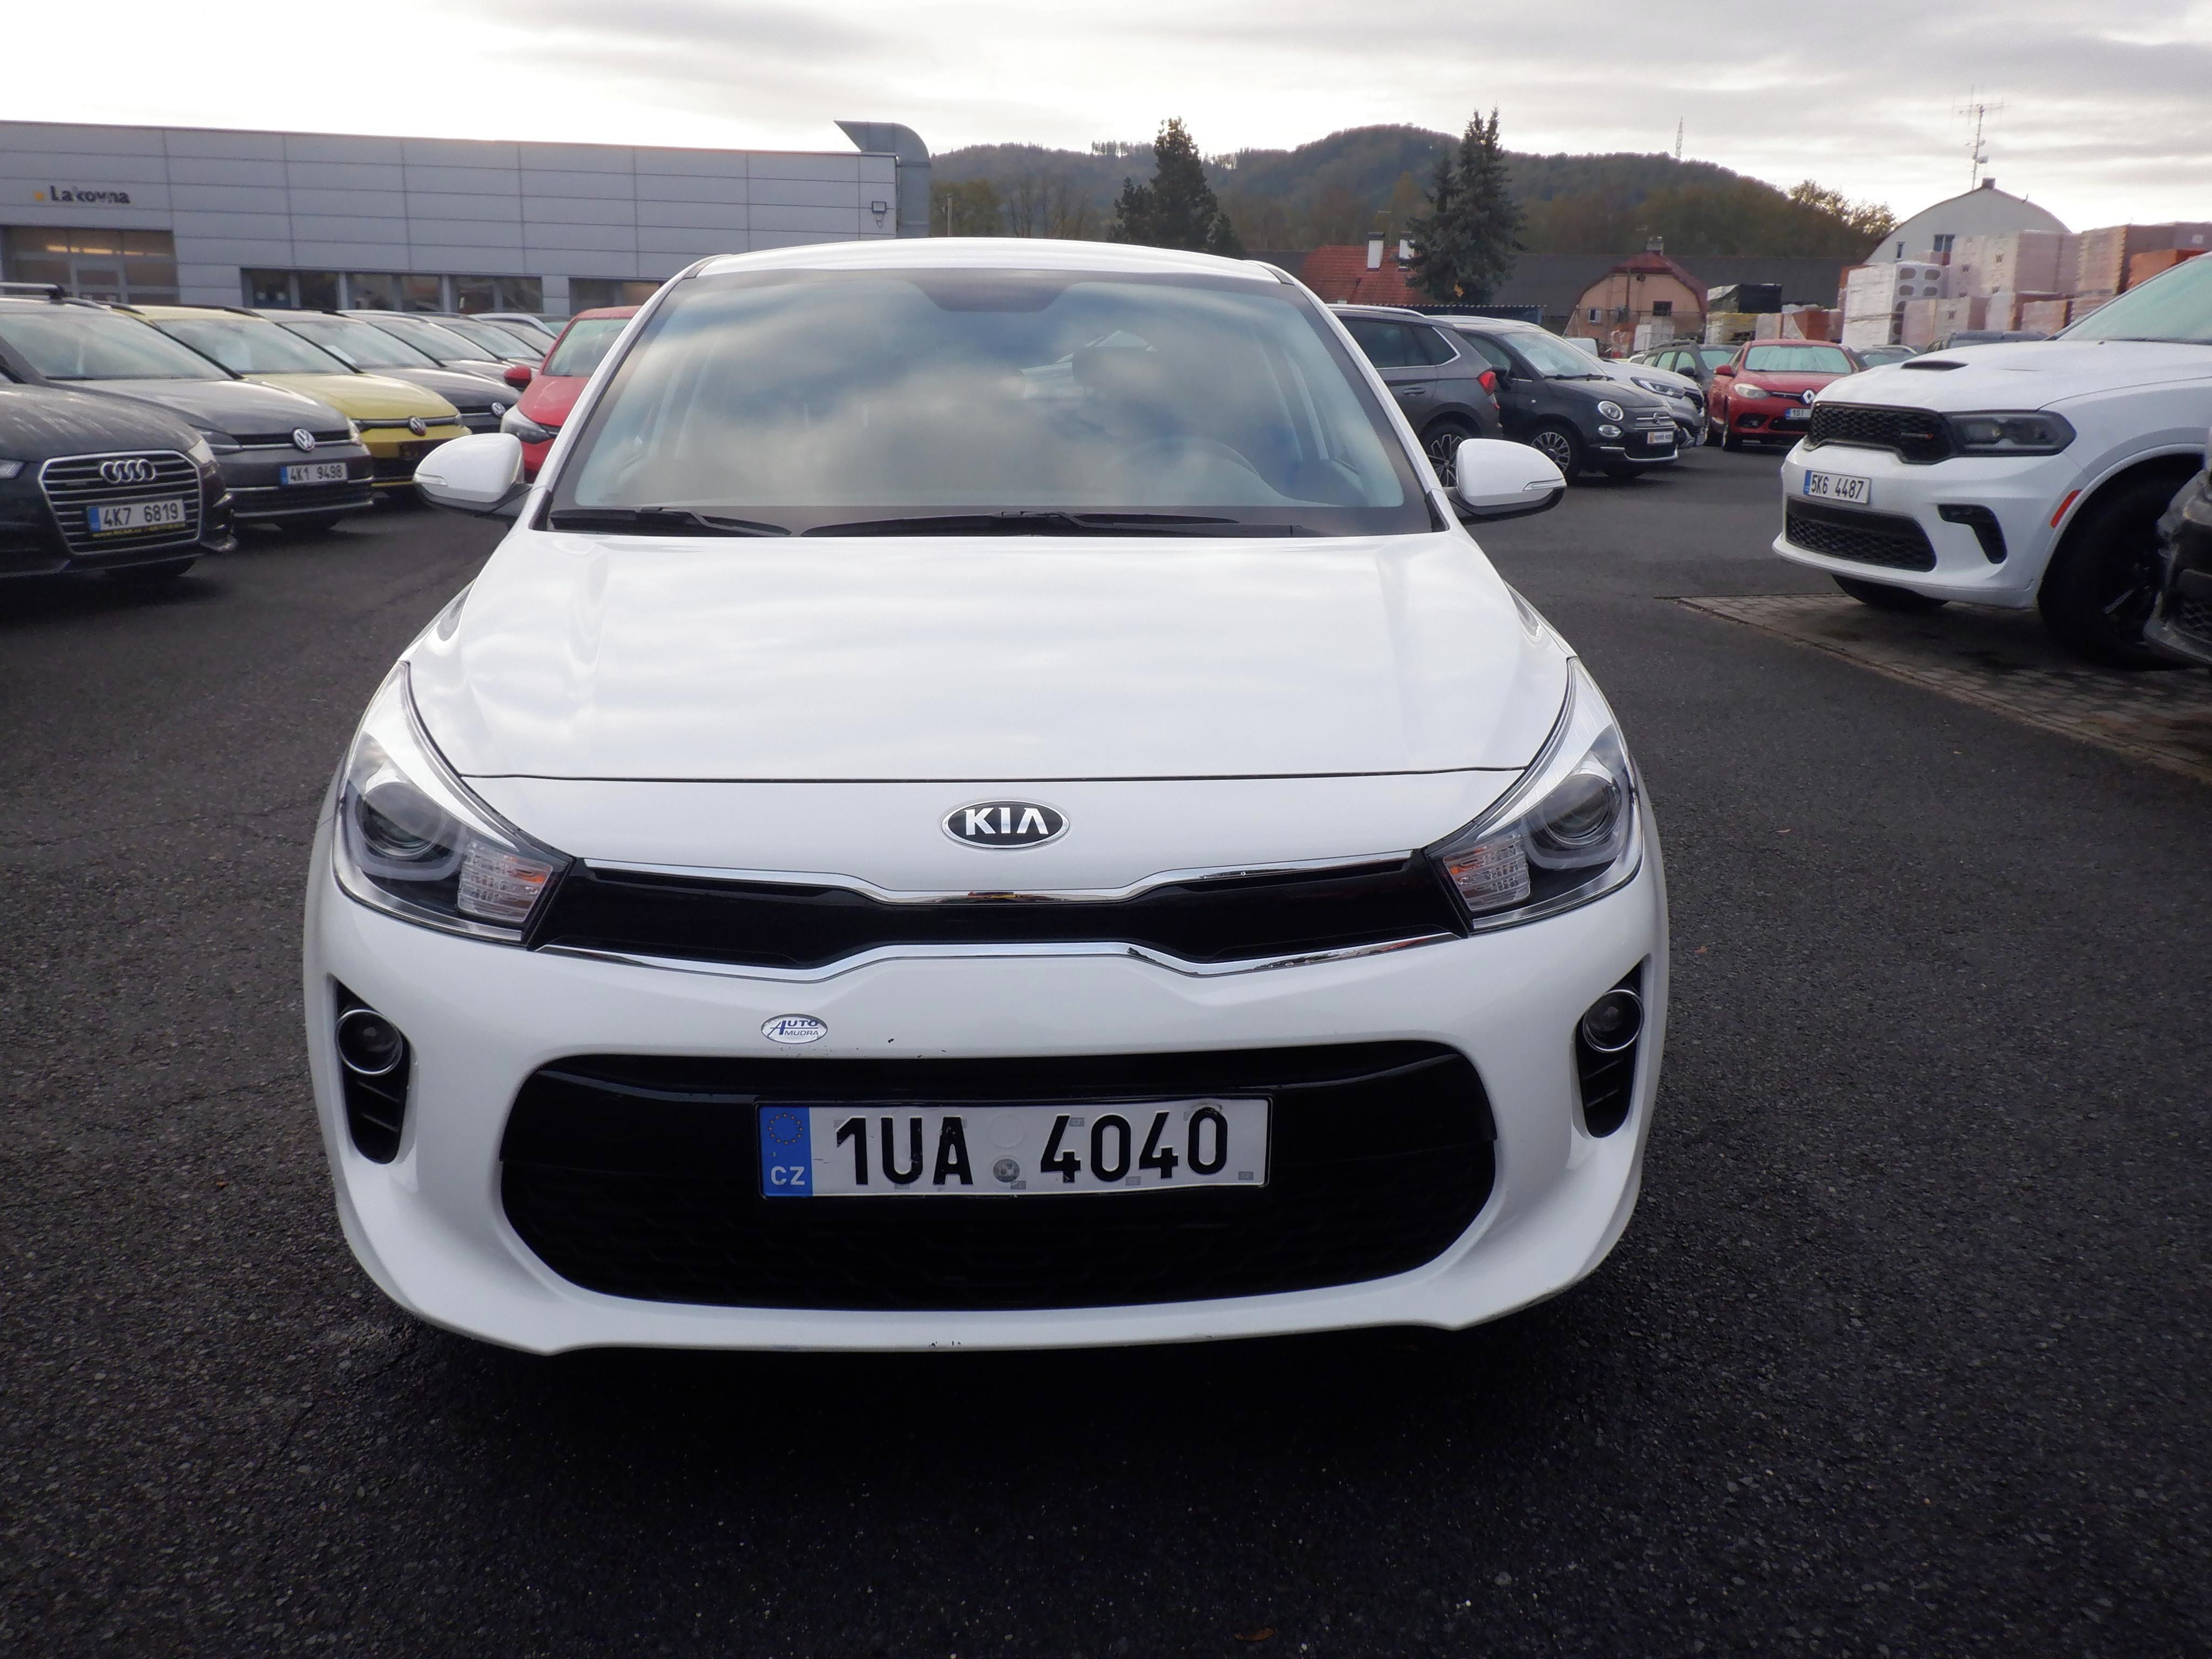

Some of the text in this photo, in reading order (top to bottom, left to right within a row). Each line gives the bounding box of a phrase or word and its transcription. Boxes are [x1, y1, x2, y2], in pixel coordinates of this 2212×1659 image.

[1811, 474, 1864, 500] 5K6 4487
[104, 502, 179, 527] 4K7 6819
[964, 807, 1049, 835] KIA
[767, 1020, 819, 1036] AUTO
[836, 1106, 1228, 1185] 1UA 4040
[771, 1166, 805, 1185] CZ
